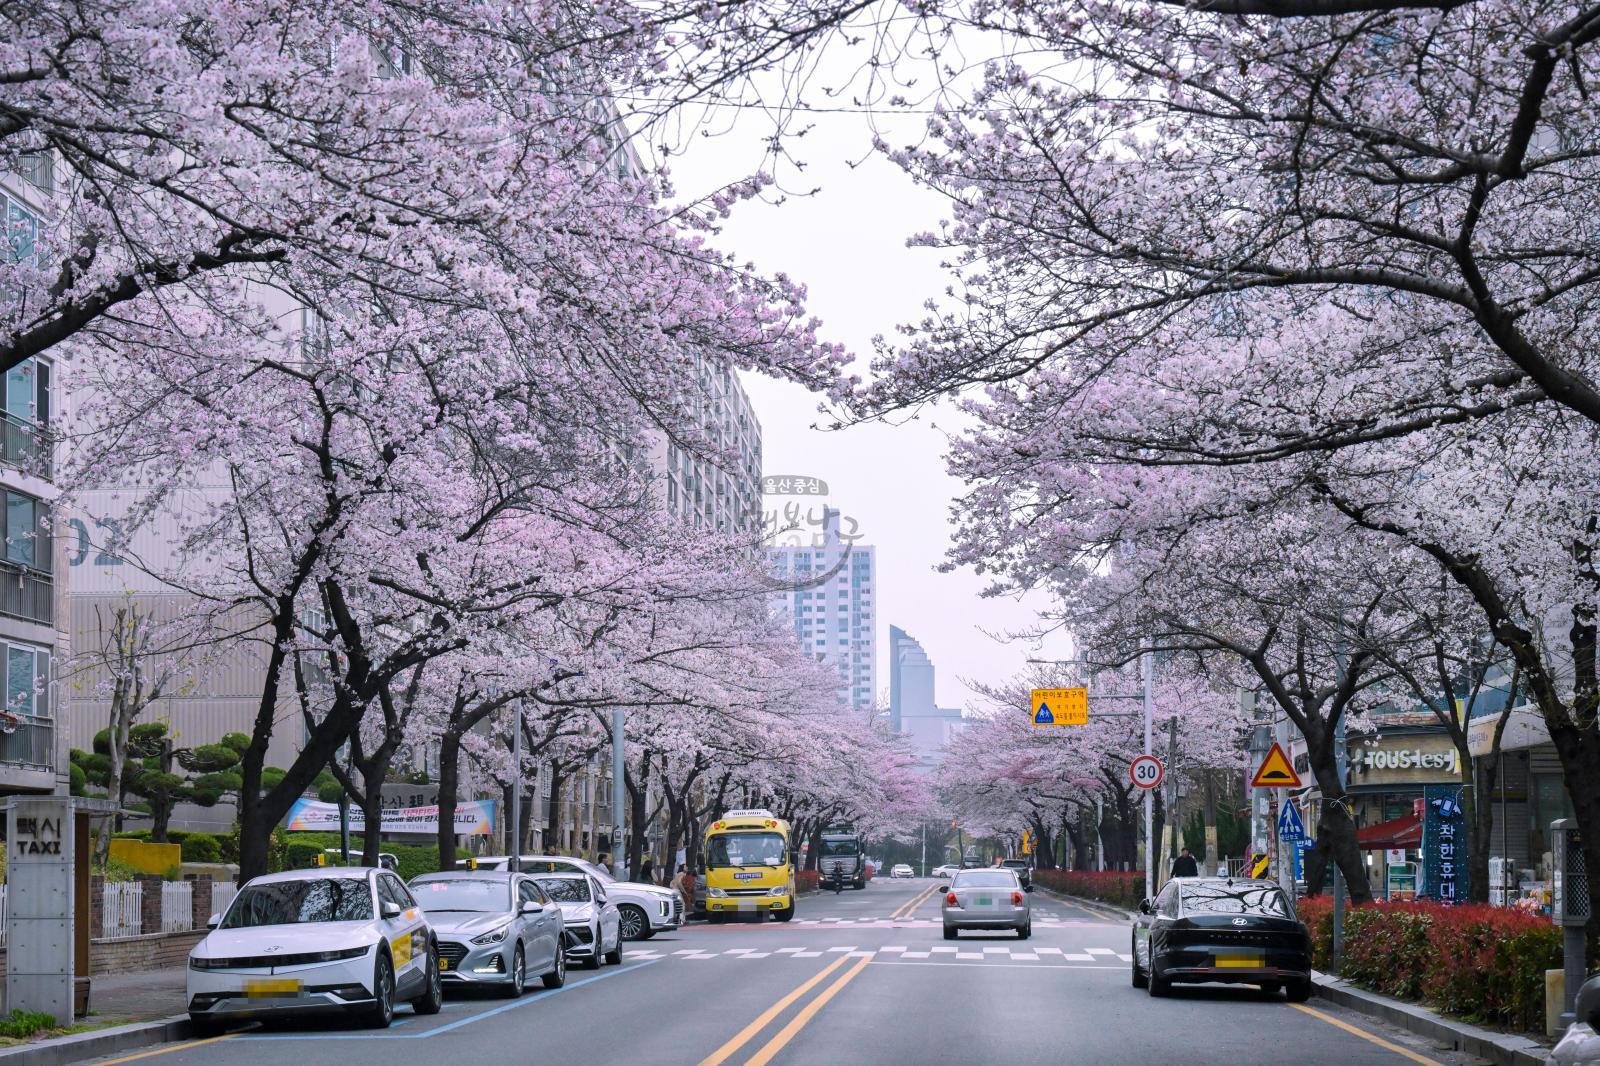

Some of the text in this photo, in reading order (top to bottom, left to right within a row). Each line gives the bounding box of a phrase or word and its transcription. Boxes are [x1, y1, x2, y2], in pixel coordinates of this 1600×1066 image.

[1034, 691, 1084, 700] 어린이보호구역
[1137, 765, 1156, 779] 30
[17, 818, 60, 839] 택시
[17, 841, 61, 854] TAXI
